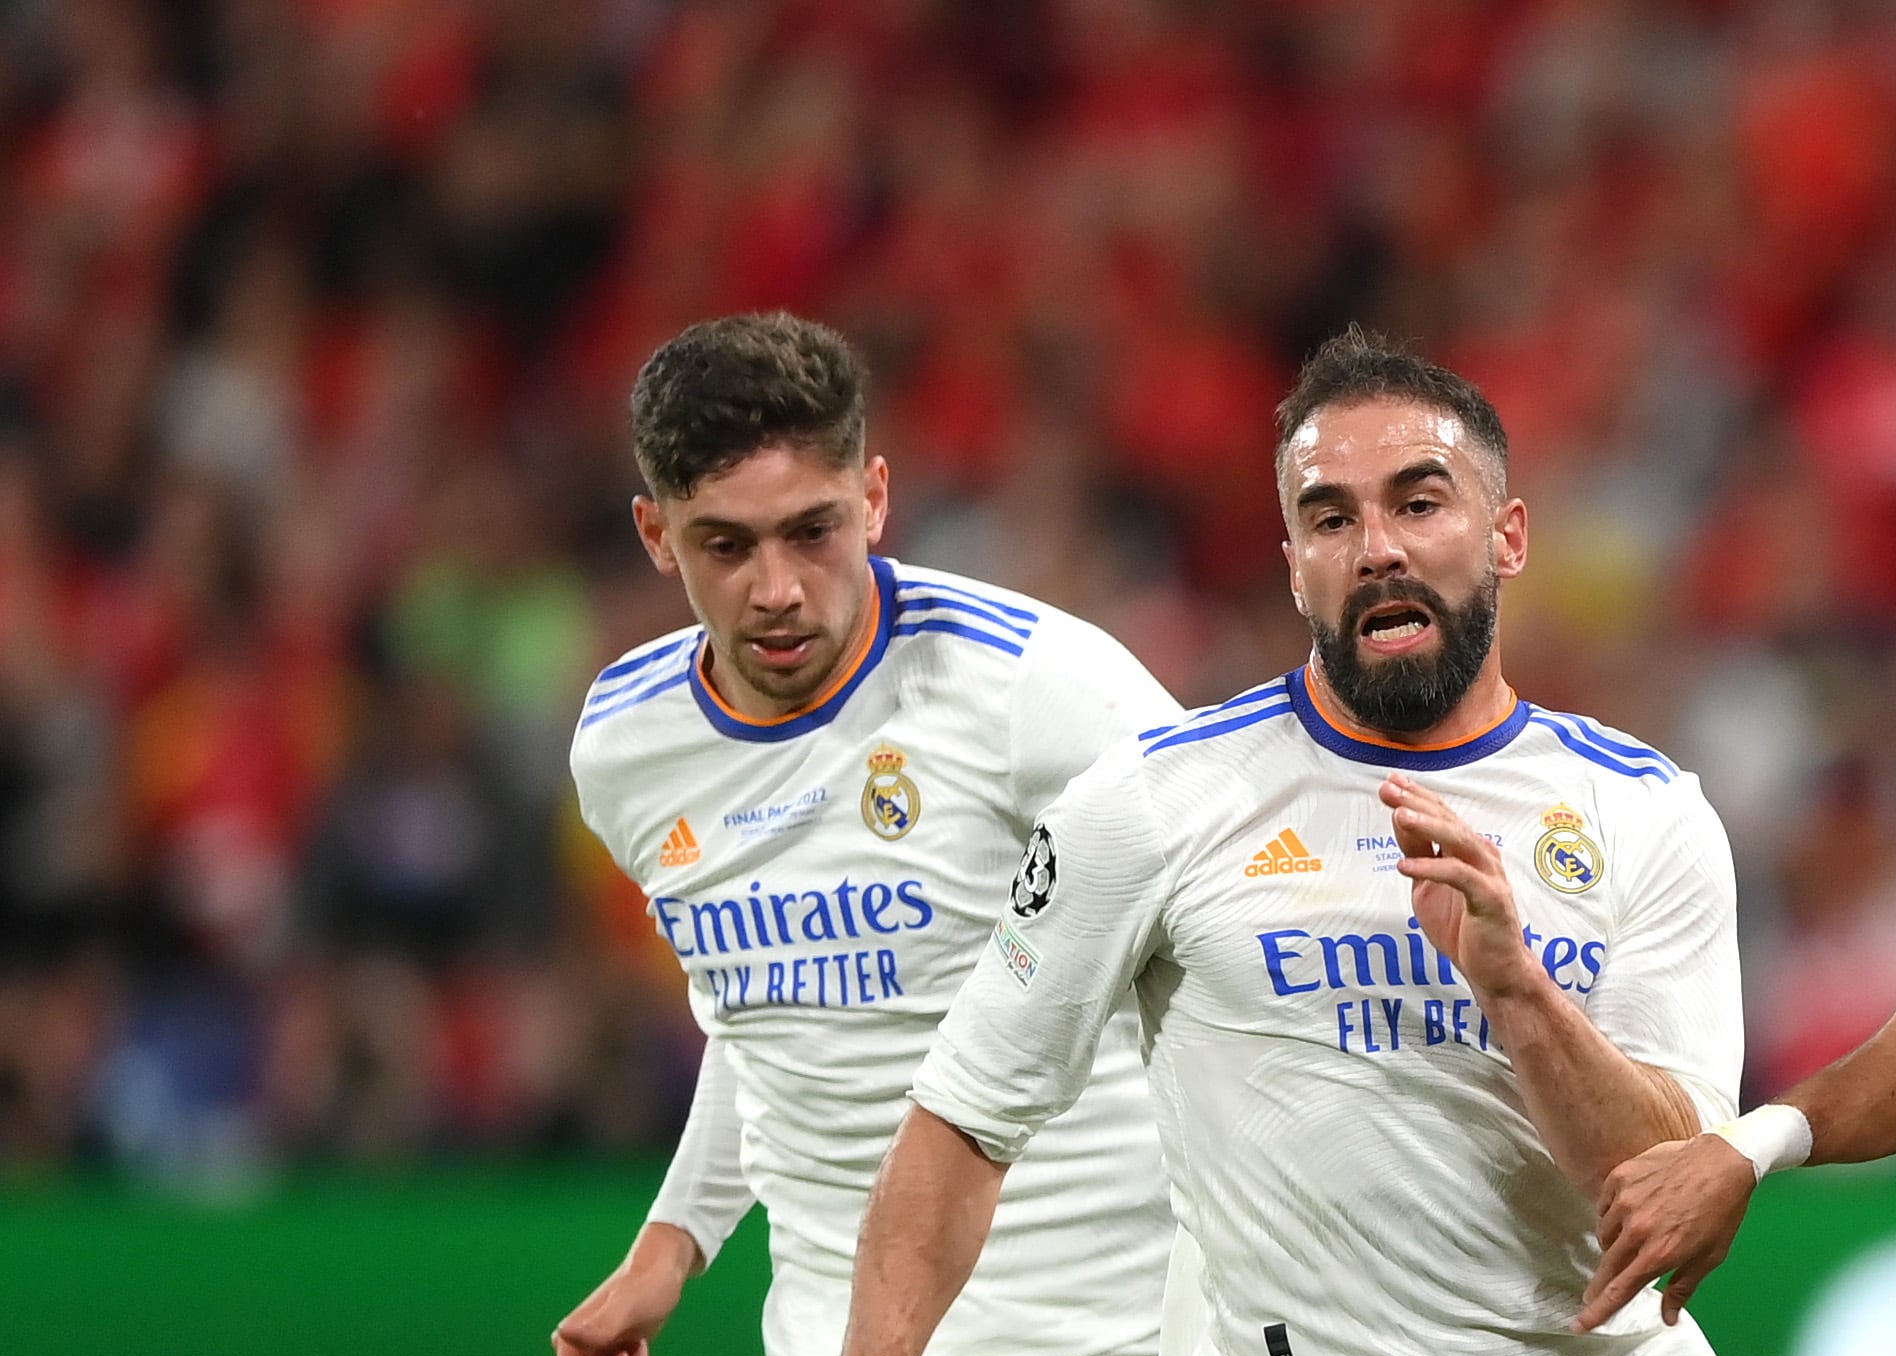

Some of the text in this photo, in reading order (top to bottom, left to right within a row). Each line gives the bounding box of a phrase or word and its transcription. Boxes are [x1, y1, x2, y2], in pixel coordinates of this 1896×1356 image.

[723, 809, 764, 829] FINAL
[1356, 836, 1398, 851] FINA
[658, 847, 702, 868] adidas
[1244, 857, 1322, 877] adidas
[654, 876, 934, 958] Emirates
[1336, 998, 1403, 1054] FLY
